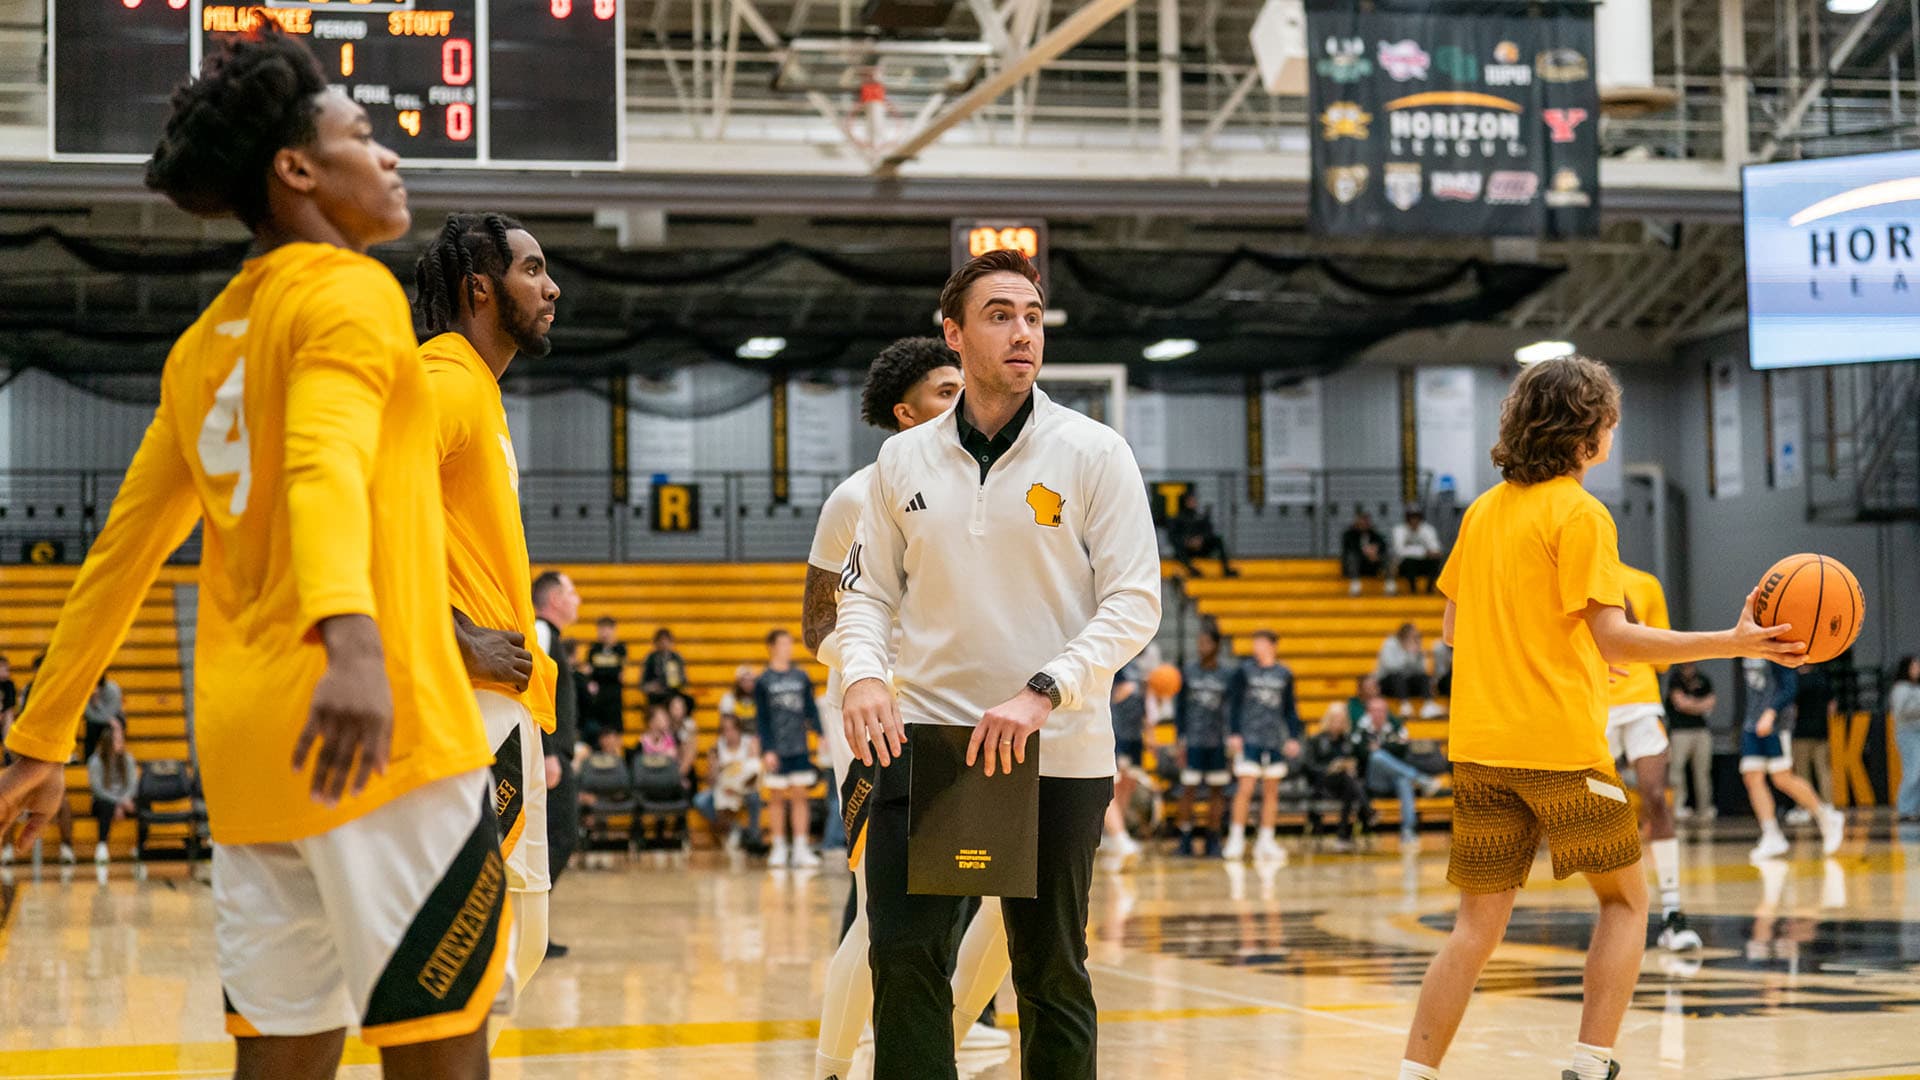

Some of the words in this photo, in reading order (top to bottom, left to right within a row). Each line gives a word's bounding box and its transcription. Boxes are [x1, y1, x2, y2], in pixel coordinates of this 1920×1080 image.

[314, 20, 367, 39] PERIOD
[388, 10, 455, 36] STOUT
[340, 42, 354, 76] 1
[442, 38, 472, 86] 0
[398, 110, 420, 137] 4
[446, 102, 472, 141] 0
[1390, 111, 1519, 140] HORIZON
[1391, 138, 1520, 157] LEAGUE
[1811, 225, 1913, 266] HOR
[1810, 271, 1909, 299] LEA
[658, 484, 691, 531] R
